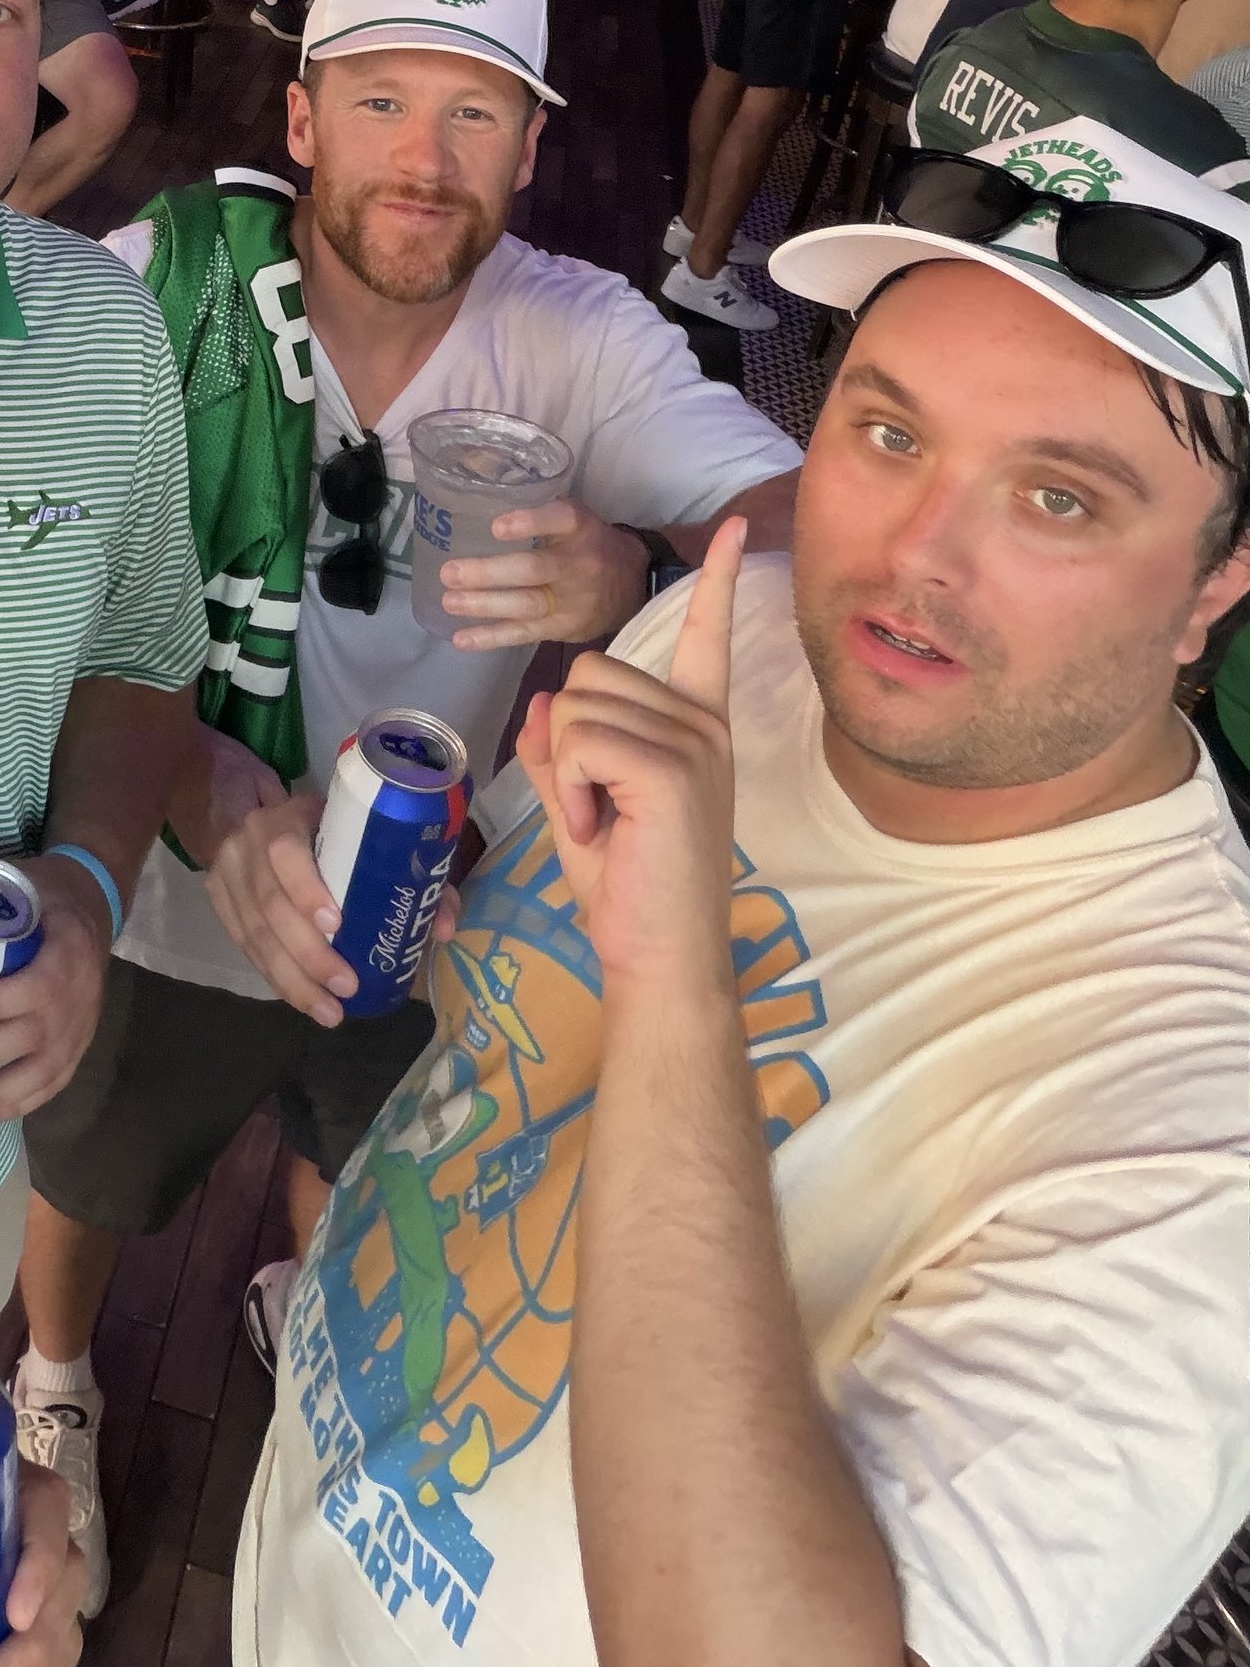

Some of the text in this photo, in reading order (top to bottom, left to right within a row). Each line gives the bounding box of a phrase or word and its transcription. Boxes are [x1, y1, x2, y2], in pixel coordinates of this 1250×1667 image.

[938, 60, 1040, 143] REVIS
[1003, 139, 1123, 184] JETHEADS
[28, 504, 81, 525] JETS
[368, 885, 417, 974] Michelob
[316, 1459, 413, 1621] HEART
[375, 1489, 477, 1649] TOWN
